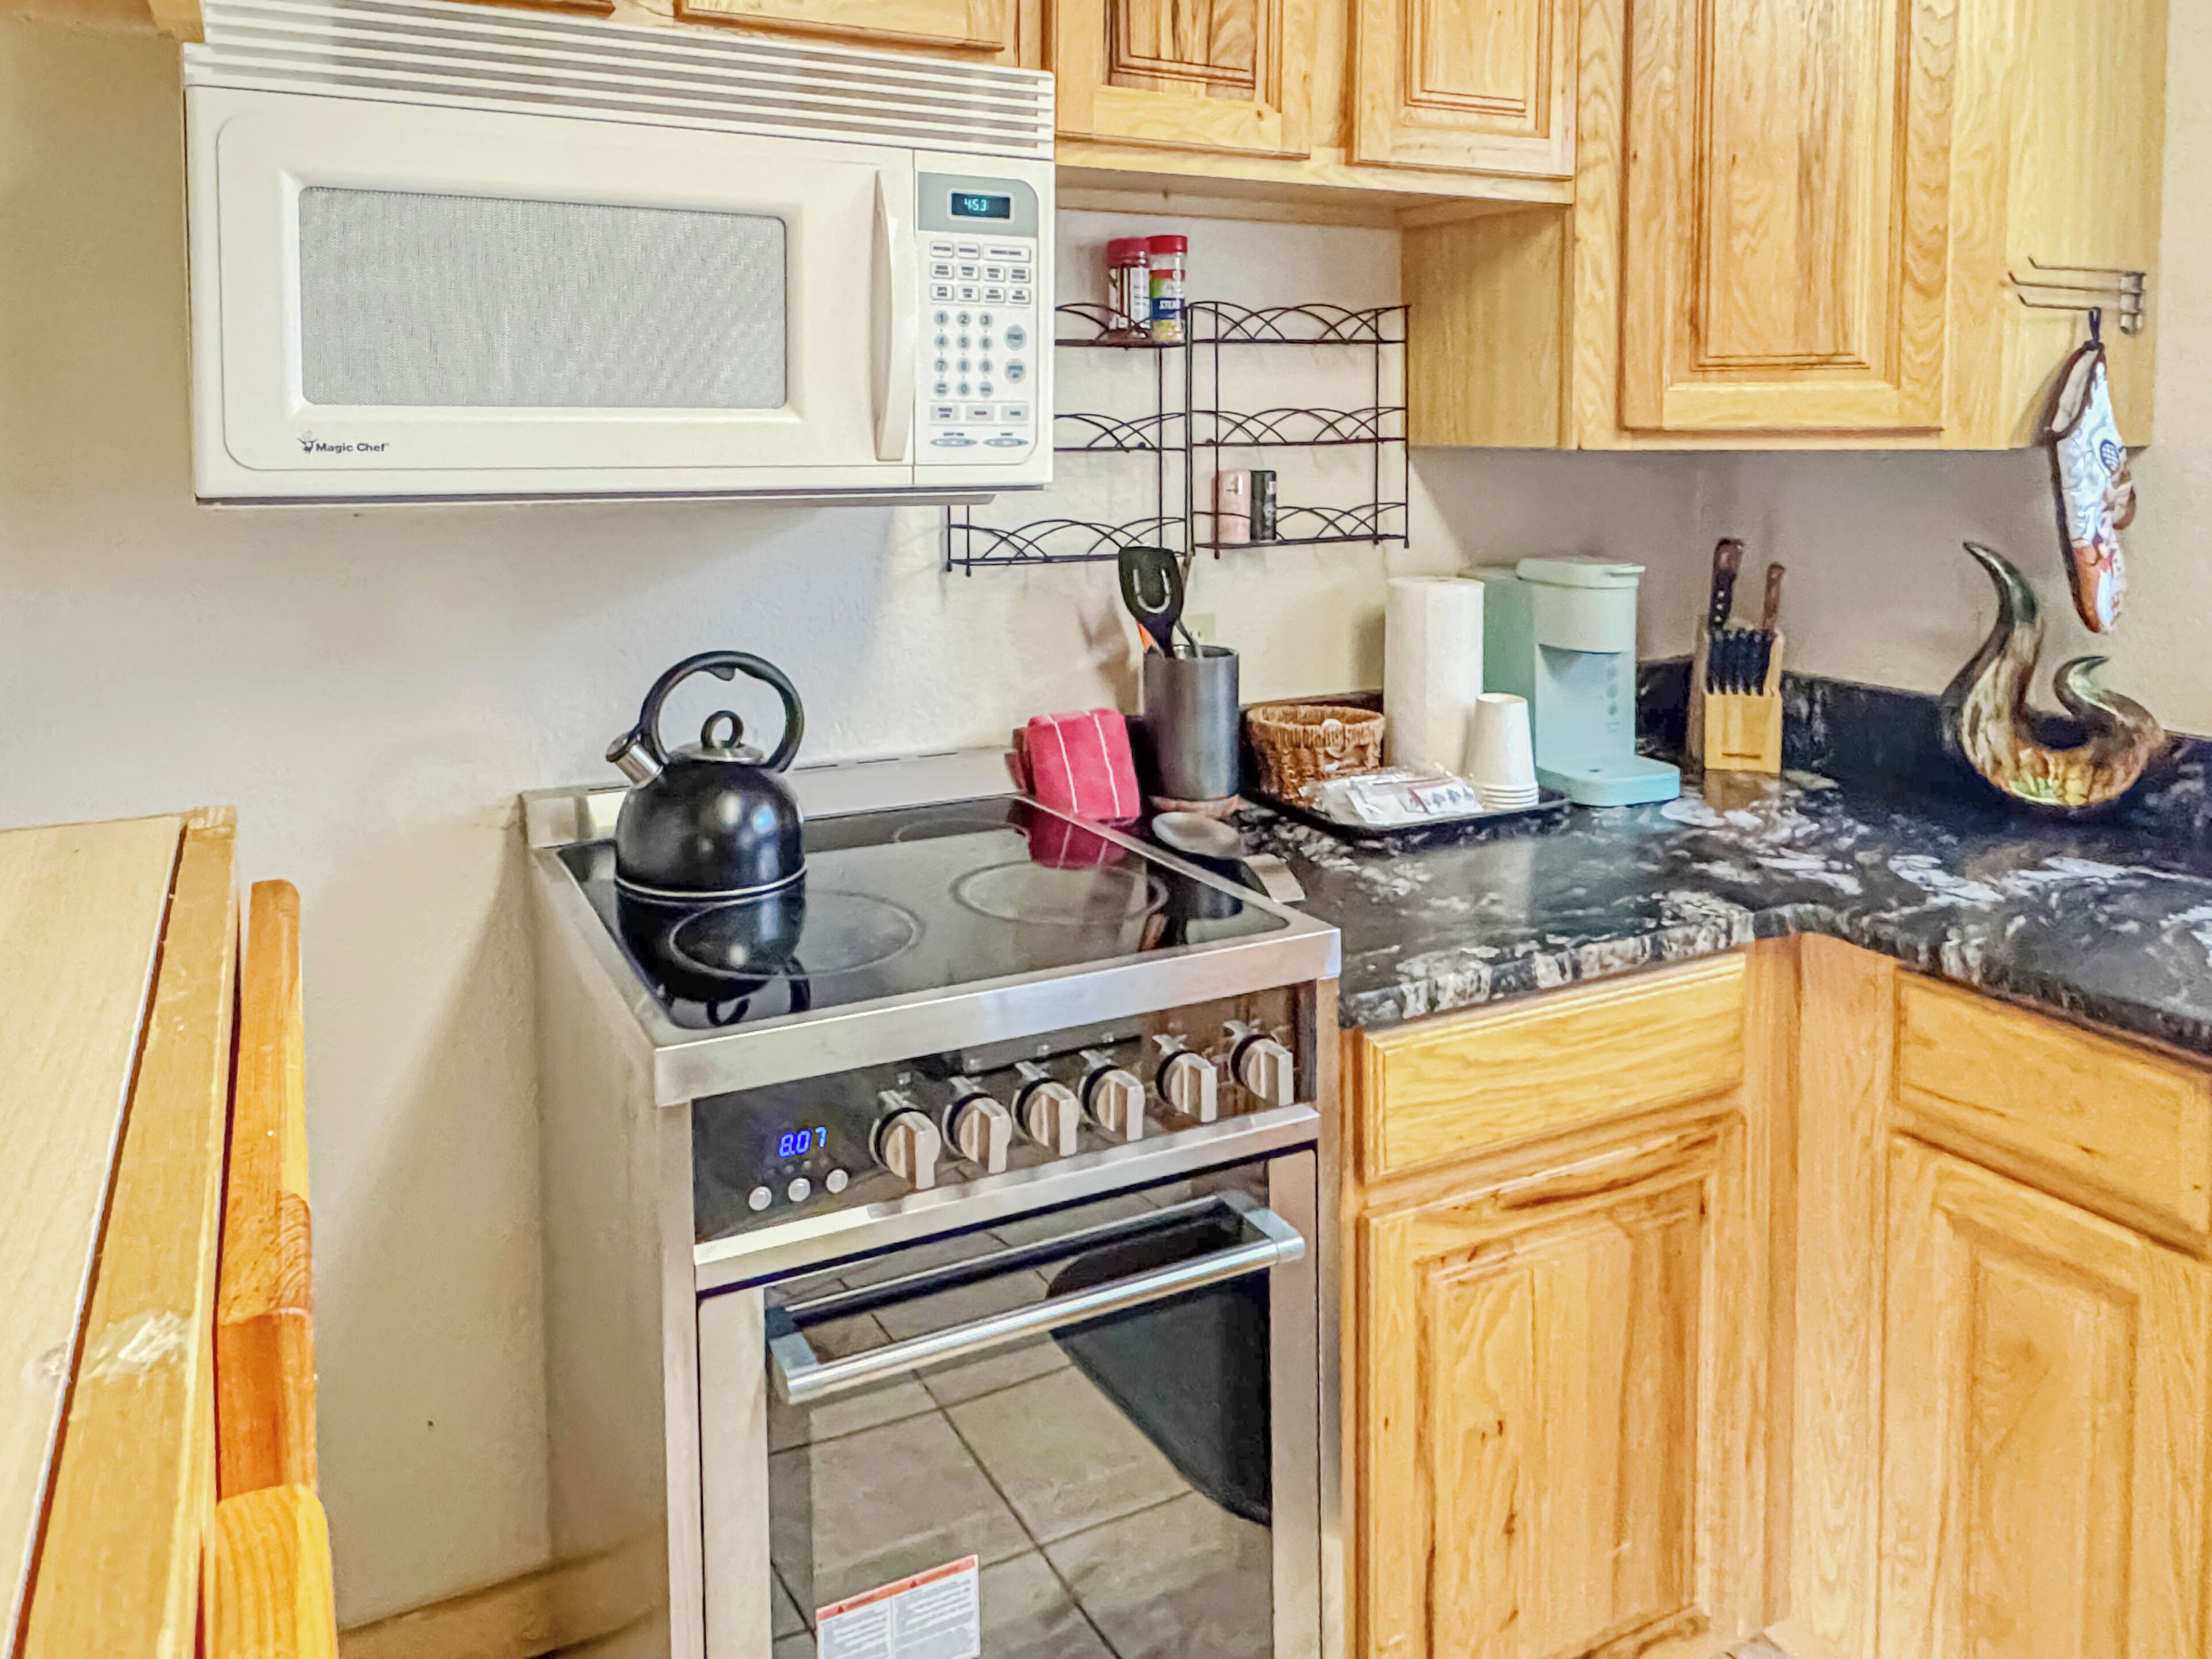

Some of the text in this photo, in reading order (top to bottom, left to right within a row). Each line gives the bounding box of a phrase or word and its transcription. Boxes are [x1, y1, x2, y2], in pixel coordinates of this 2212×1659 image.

[960, 315, 967, 324] 2
[983, 315, 989, 325] 3
[938, 336, 945, 346] 4
[961, 337, 967, 347] 5
[938, 360, 945, 372] 7
[961, 384, 967, 394] 0
[316, 442, 385, 453] Magic Chef
